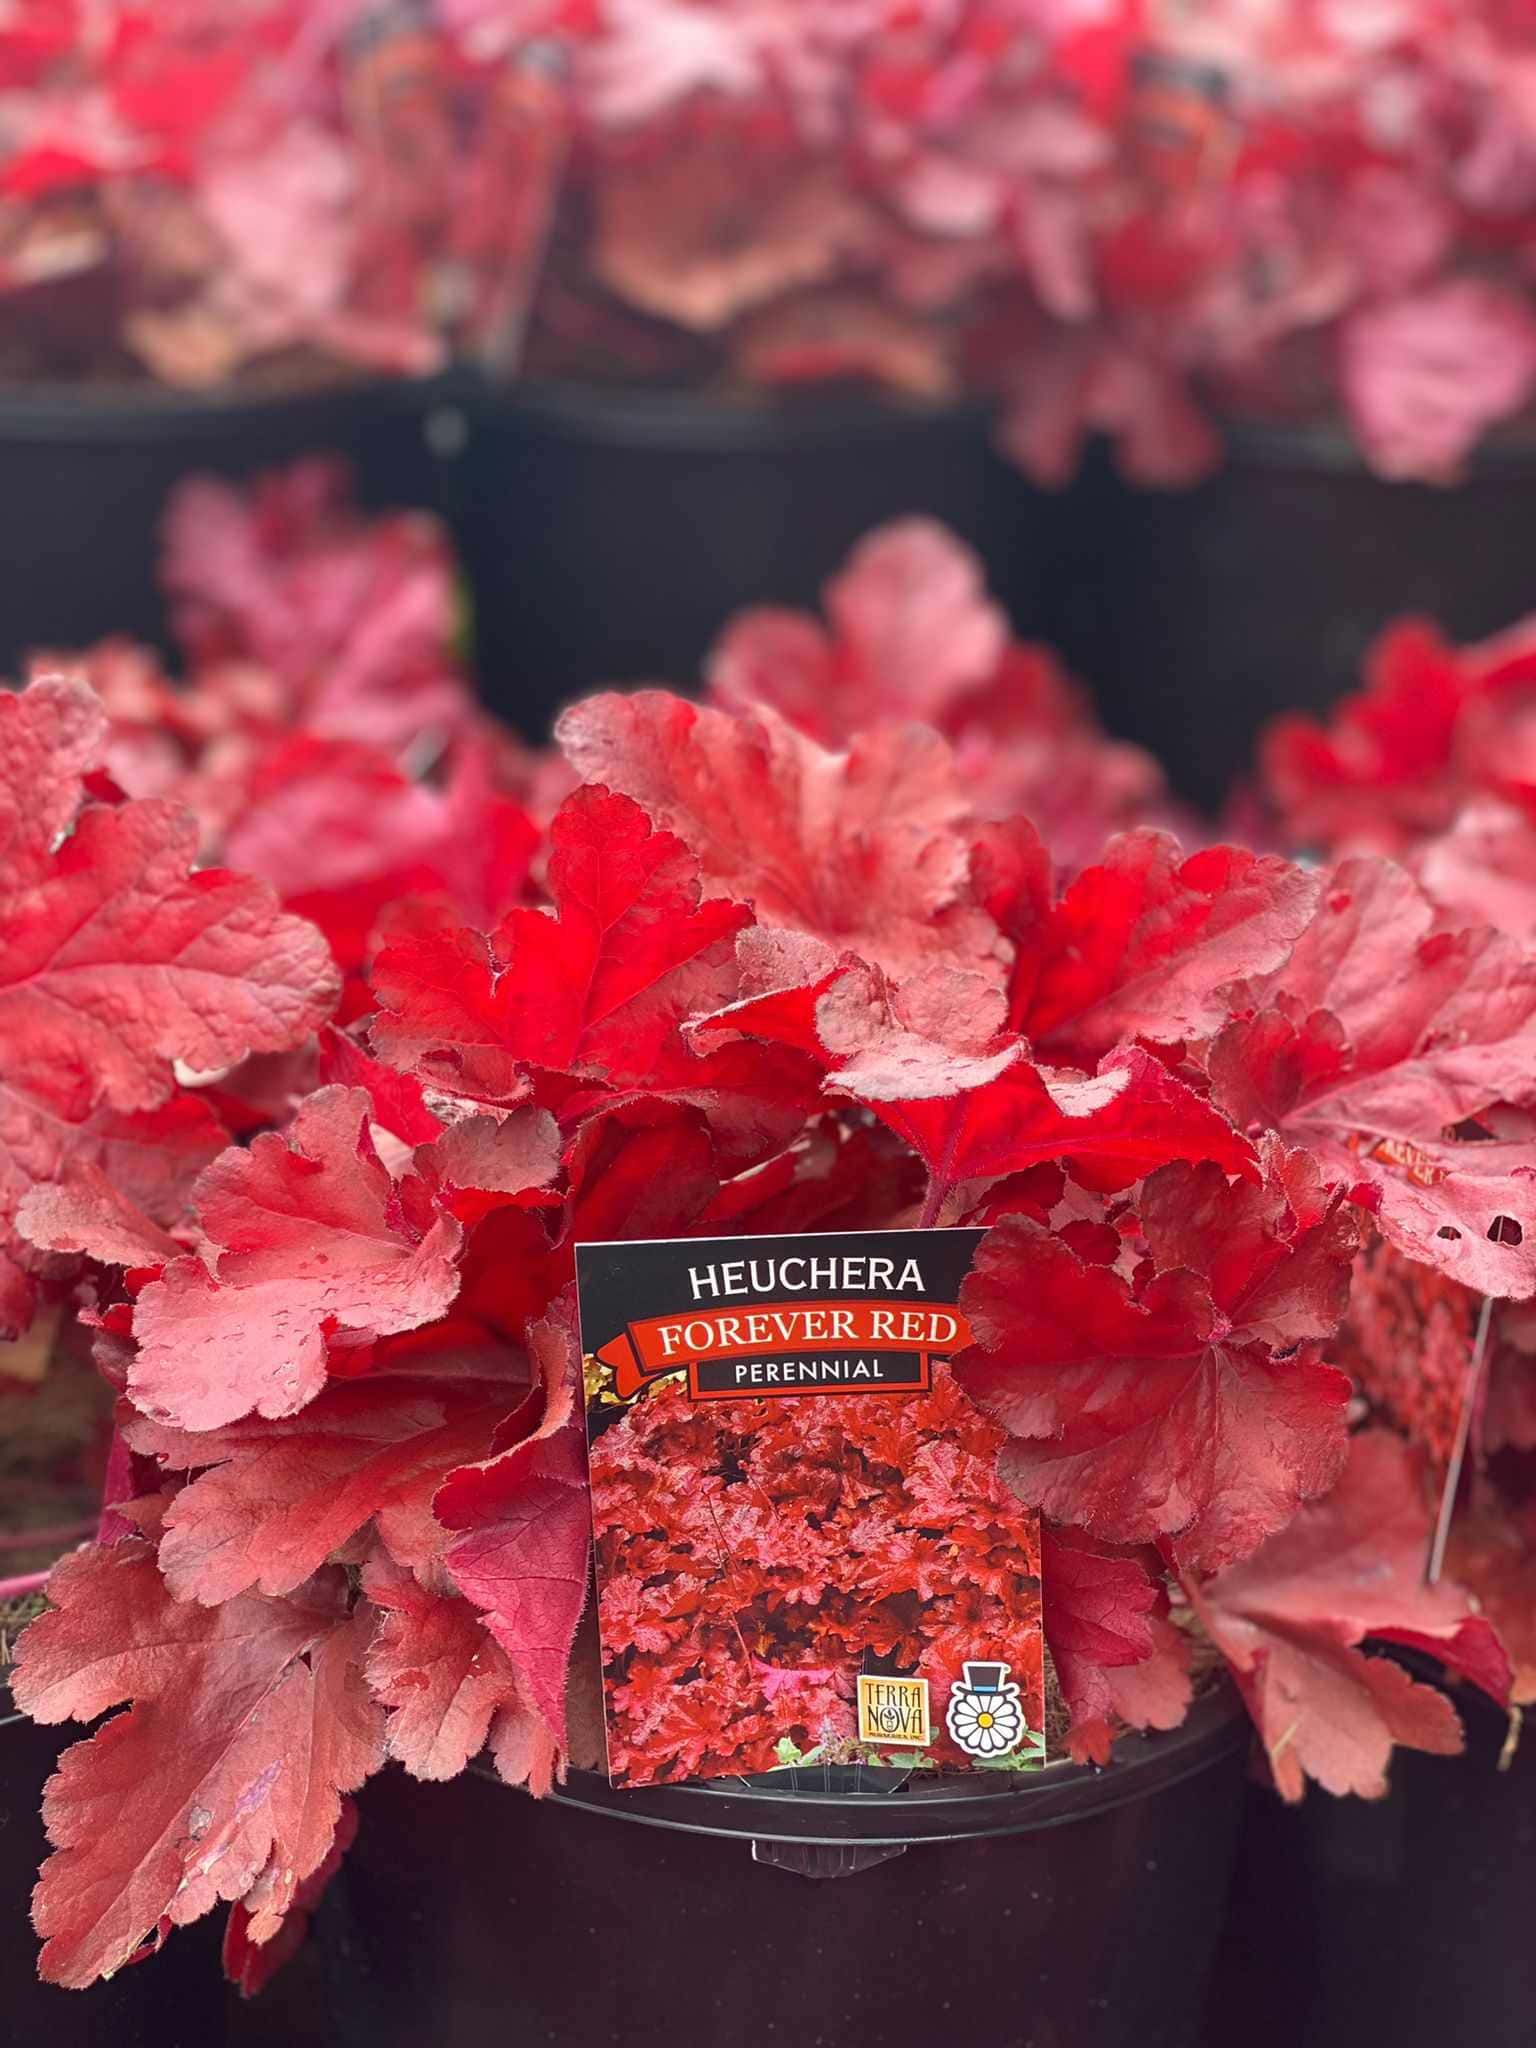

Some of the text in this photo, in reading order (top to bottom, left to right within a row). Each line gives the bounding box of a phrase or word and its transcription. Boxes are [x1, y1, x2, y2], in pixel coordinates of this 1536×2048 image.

[687, 1256, 926, 1300] HEUCHERA
[657, 1309, 957, 1356] FOREVER RED
[735, 1358, 884, 1384] PERENNIAL
[865, 1682, 921, 1707] TERRA
[867, 1705, 923, 1734] NOVA
